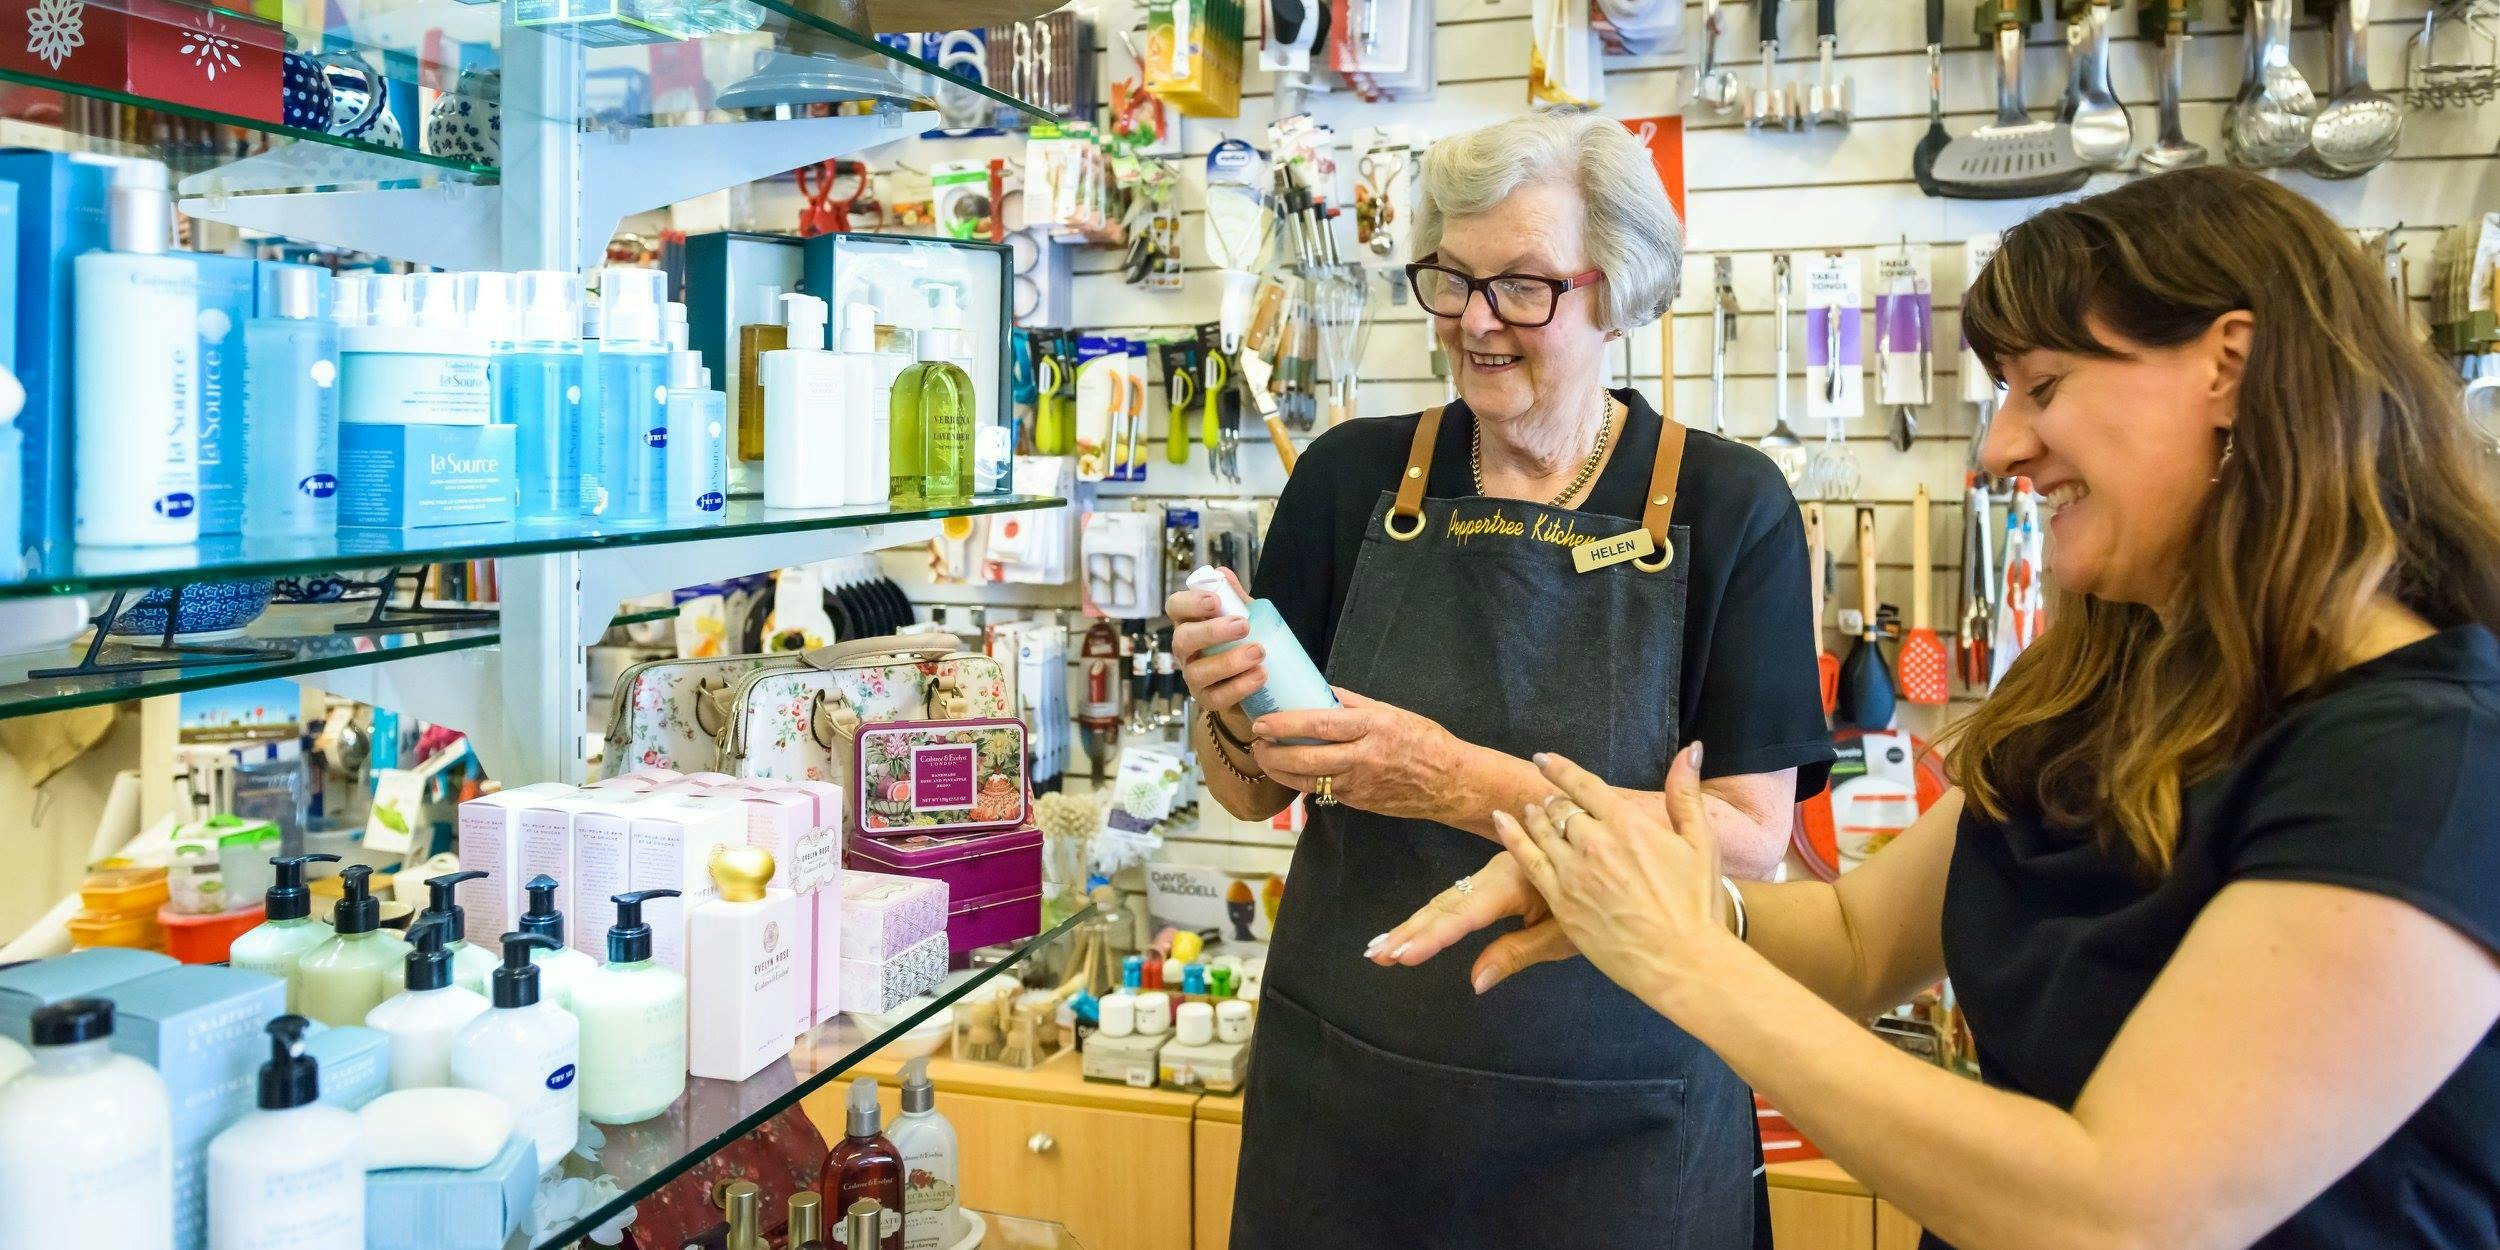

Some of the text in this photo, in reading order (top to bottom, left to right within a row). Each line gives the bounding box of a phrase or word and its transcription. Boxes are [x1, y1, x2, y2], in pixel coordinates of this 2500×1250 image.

[1879, 269, 1917, 277] TONGS
[1811, 282, 1848, 290] TONGS
[198, 350, 223, 439] Source
[933, 415, 970, 425] VERBENA
[933, 432, 970, 441] LAVENDER
[431, 453, 497, 475] La Source
[1590, 540, 1636, 561] HELEN
[802, 844, 830, 863] EVELYN ROSE
[1151, 871, 1188, 884] DAVIS
[1159, 883, 1219, 898] WADDELL
[754, 948, 789, 975] EVELYN ROSE
[843, 1182, 868, 1191] Crabtree
